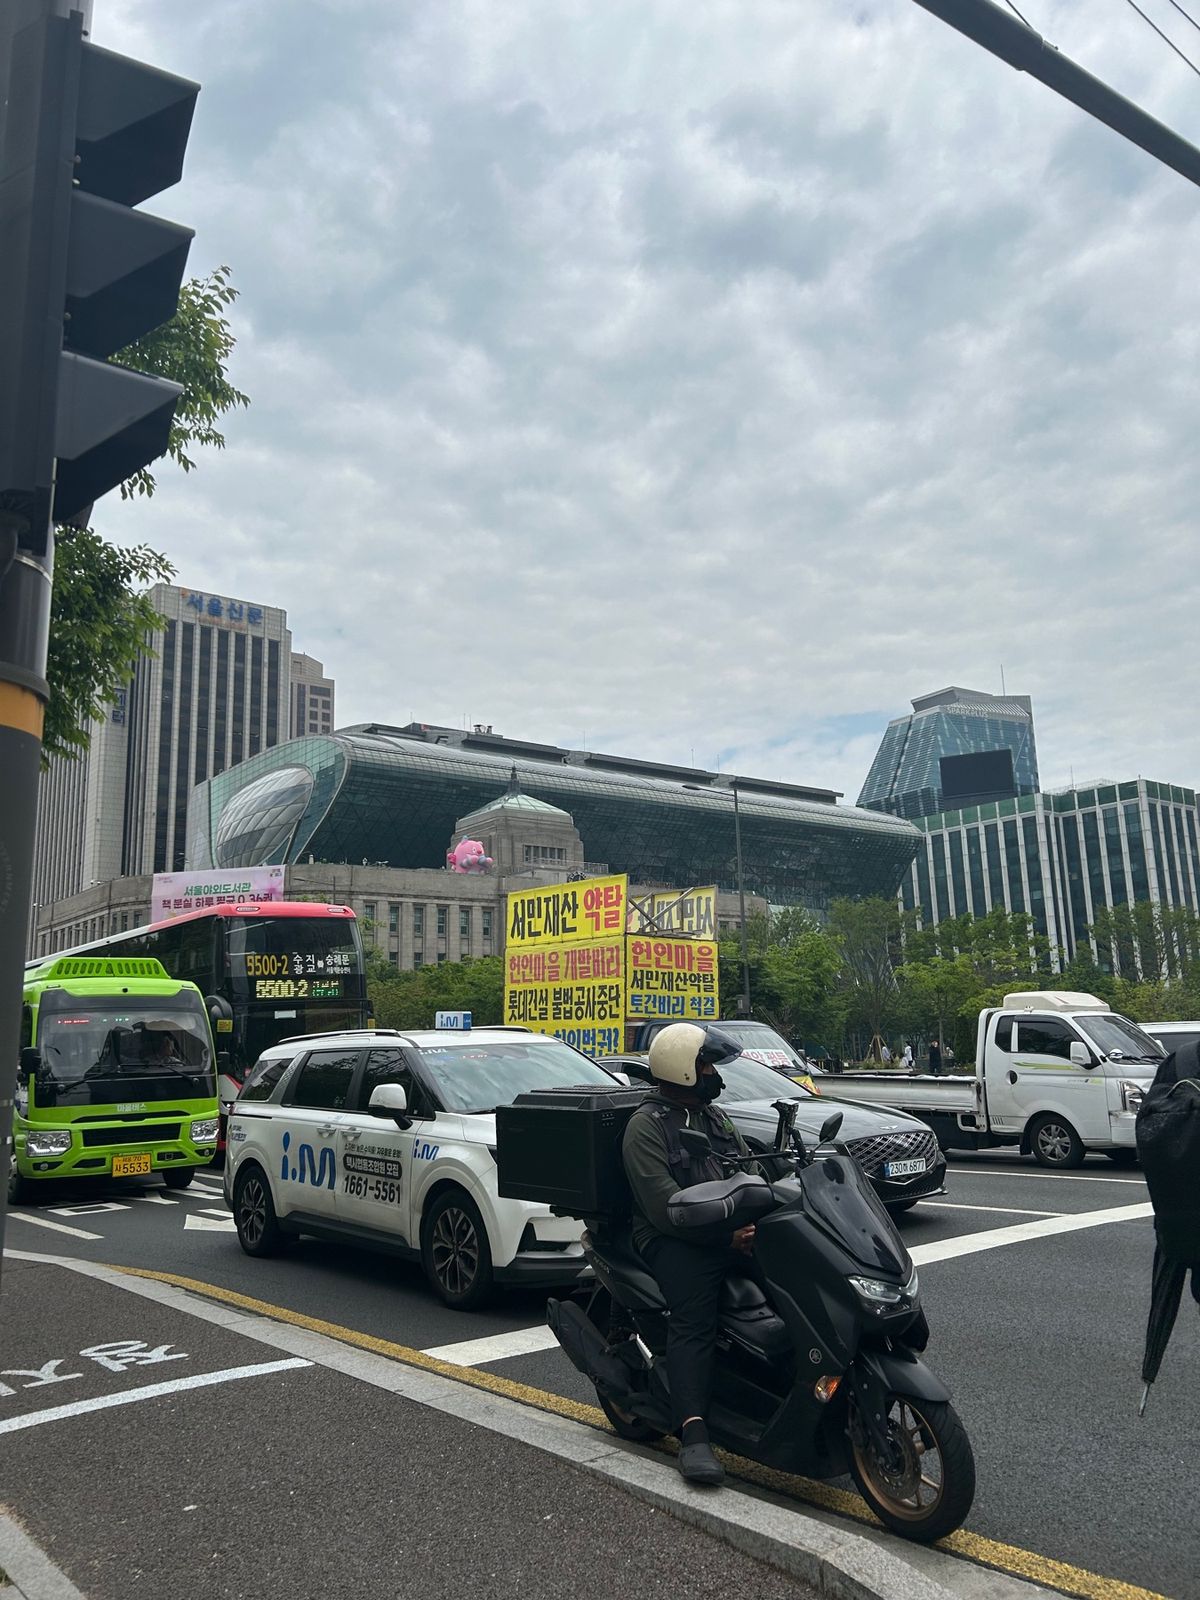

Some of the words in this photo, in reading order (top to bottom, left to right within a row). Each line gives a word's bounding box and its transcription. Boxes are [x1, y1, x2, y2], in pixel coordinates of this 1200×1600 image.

[187, 593, 263, 625] 서울신문
[184, 882, 252, 896] 서울야외도서관
[162, 898, 171, 909] 책
[173, 897, 192, 909] 분실
[195, 897, 214, 908] 하루
[511, 891, 579, 940] 서민재산
[583, 885, 623, 931] 약탈
[246, 954, 289, 976] 5500-2
[325, 954, 350, 965] 숭례문
[509, 951, 560, 984] 헌인마을
[564, 945, 620, 980] 개발비리
[631, 941, 715, 972] 헌인마을
[256, 979, 309, 998] 5500-2
[630, 969, 716, 993] 서민재산약탈
[509, 988, 549, 1022] 롯데건설
[552, 984, 621, 1020] 불법공사중단
[630, 994, 685, 1016] 토건비리
[690, 996, 716, 1017] 척결
[116, 1102, 147, 1112] 마을버스
[281, 1131, 336, 1190] i.M
[413, 1139, 440, 1161] i.M
[346, 1156, 386, 1175] 택시협동조합원
[386, 1163, 399, 1177] 모집
[344, 1174, 401, 1204] 1661-5561
